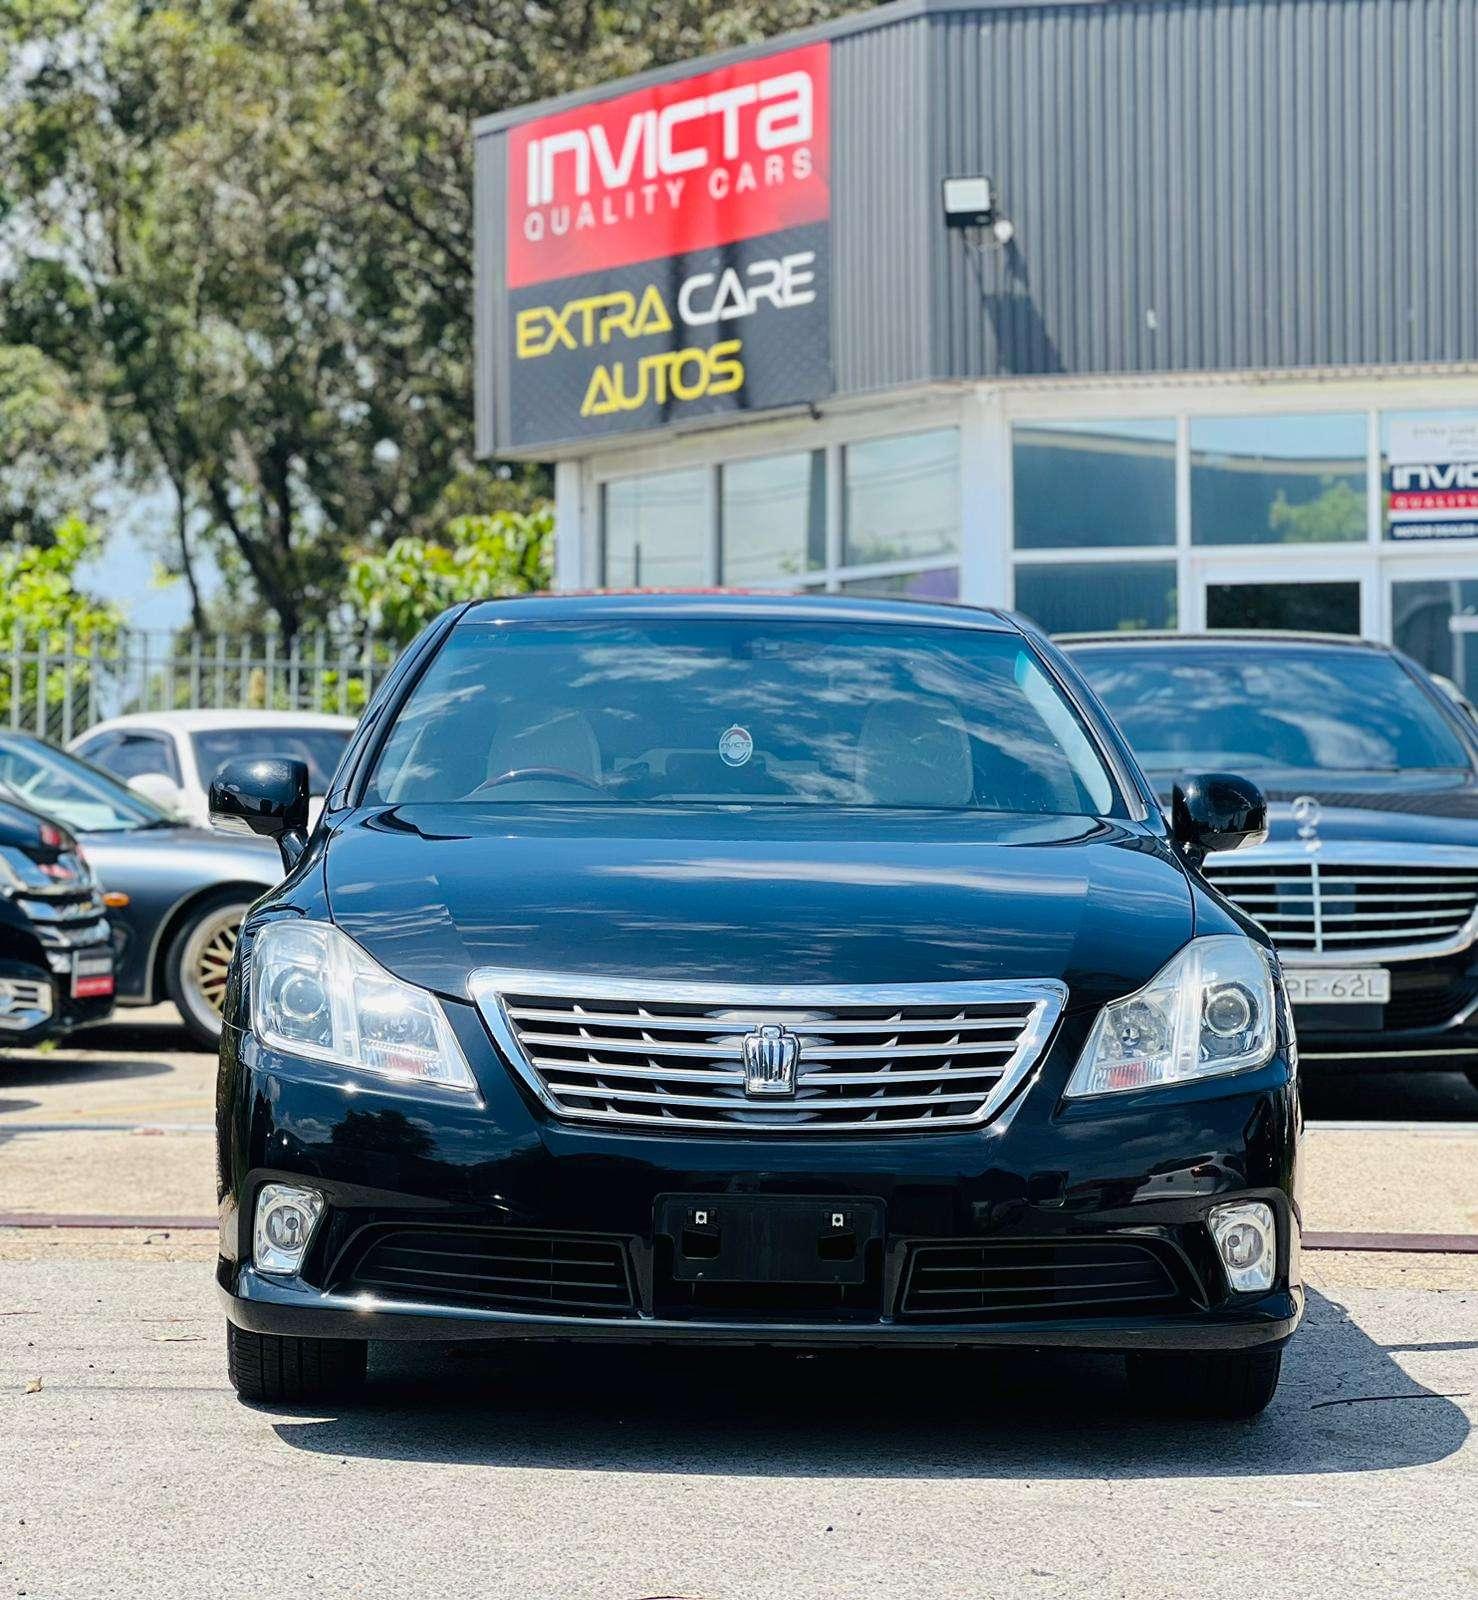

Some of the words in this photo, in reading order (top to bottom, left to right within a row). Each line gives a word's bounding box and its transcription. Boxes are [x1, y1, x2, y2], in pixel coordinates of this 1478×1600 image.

[527, 70, 814, 207] INVICTA
[524, 178, 686, 242] QUALITY
[708, 147, 813, 199] CARS
[516, 284, 673, 360] EXTRA
[678, 250, 815, 327] CARE
[581, 339, 746, 417] AUTOS
